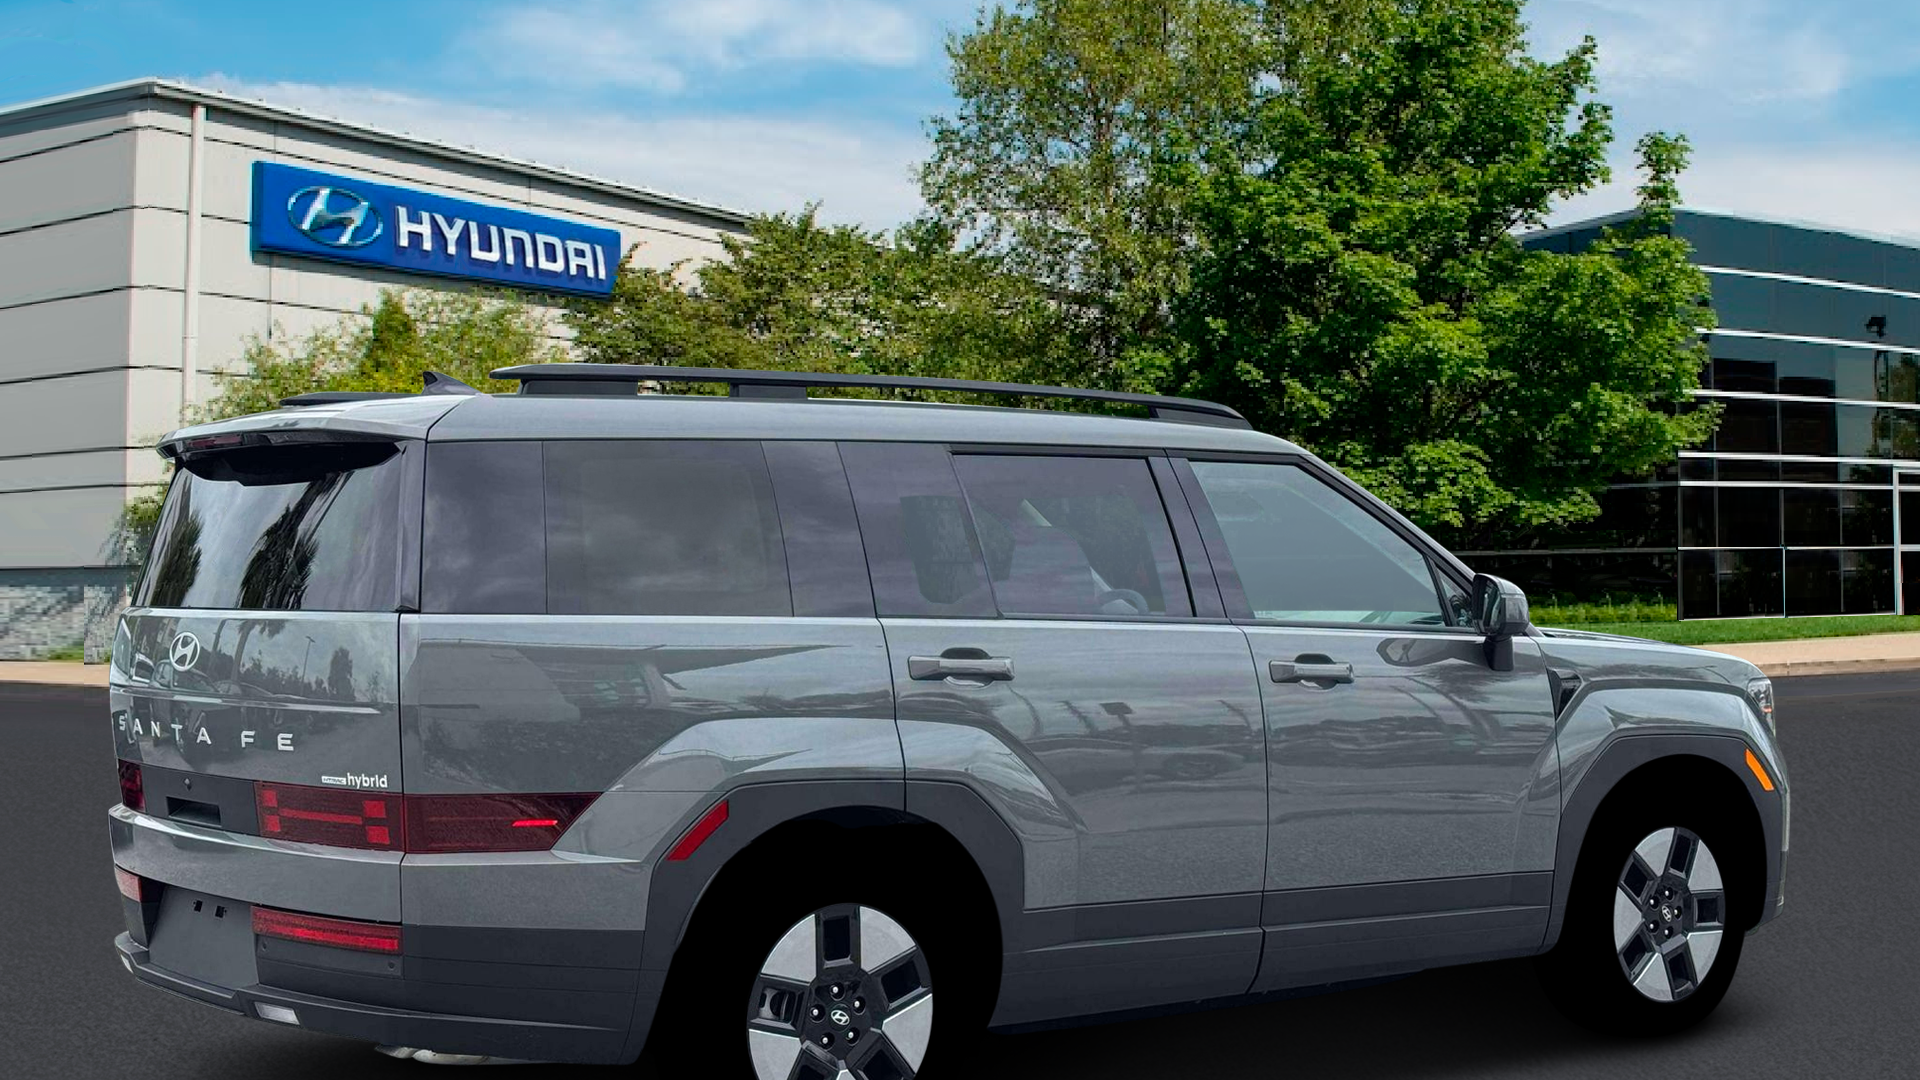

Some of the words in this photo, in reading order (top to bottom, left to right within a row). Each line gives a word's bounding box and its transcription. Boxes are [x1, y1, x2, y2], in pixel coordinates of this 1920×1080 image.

[397, 205, 606, 280] HYUNDAI
[118, 714, 212, 745] SANTA
[240, 730, 294, 751] FE
[346, 772, 388, 789] hybrid
